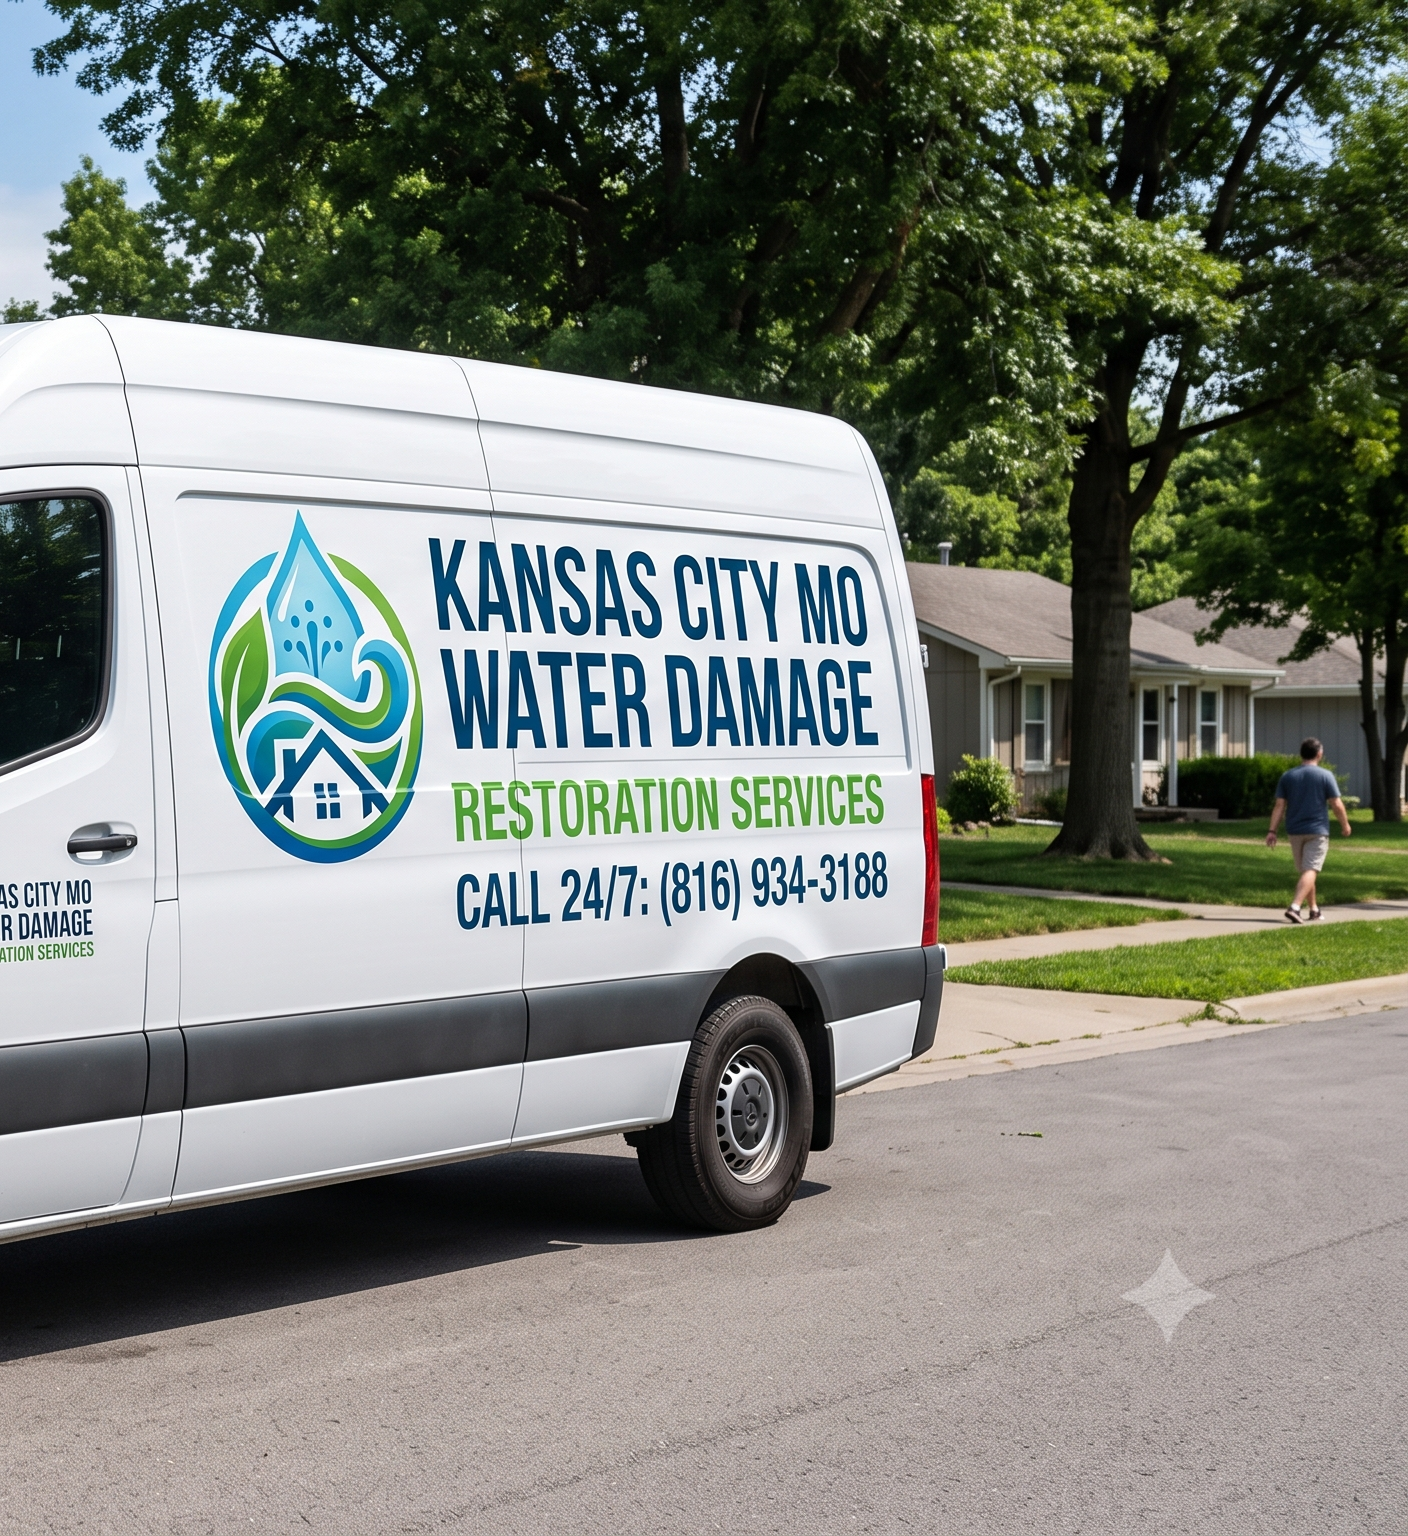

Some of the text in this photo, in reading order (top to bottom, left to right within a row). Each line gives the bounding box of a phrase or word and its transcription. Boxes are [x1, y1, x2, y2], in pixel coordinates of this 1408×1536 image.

[428, 537, 869, 647] KANSAS CITY MO
[440, 648, 880, 750] WATER DAMAGE
[451, 773, 885, 842] RESTORATION SERVICES
[18, 909, 93, 940] DAMAGE
[23, 881, 61, 908] CITY
[66, 879, 92, 905] MO
[456, 850, 888, 930] CALL 24/7: (816) 934-3188
[37, 941, 94, 960] SERVICES
